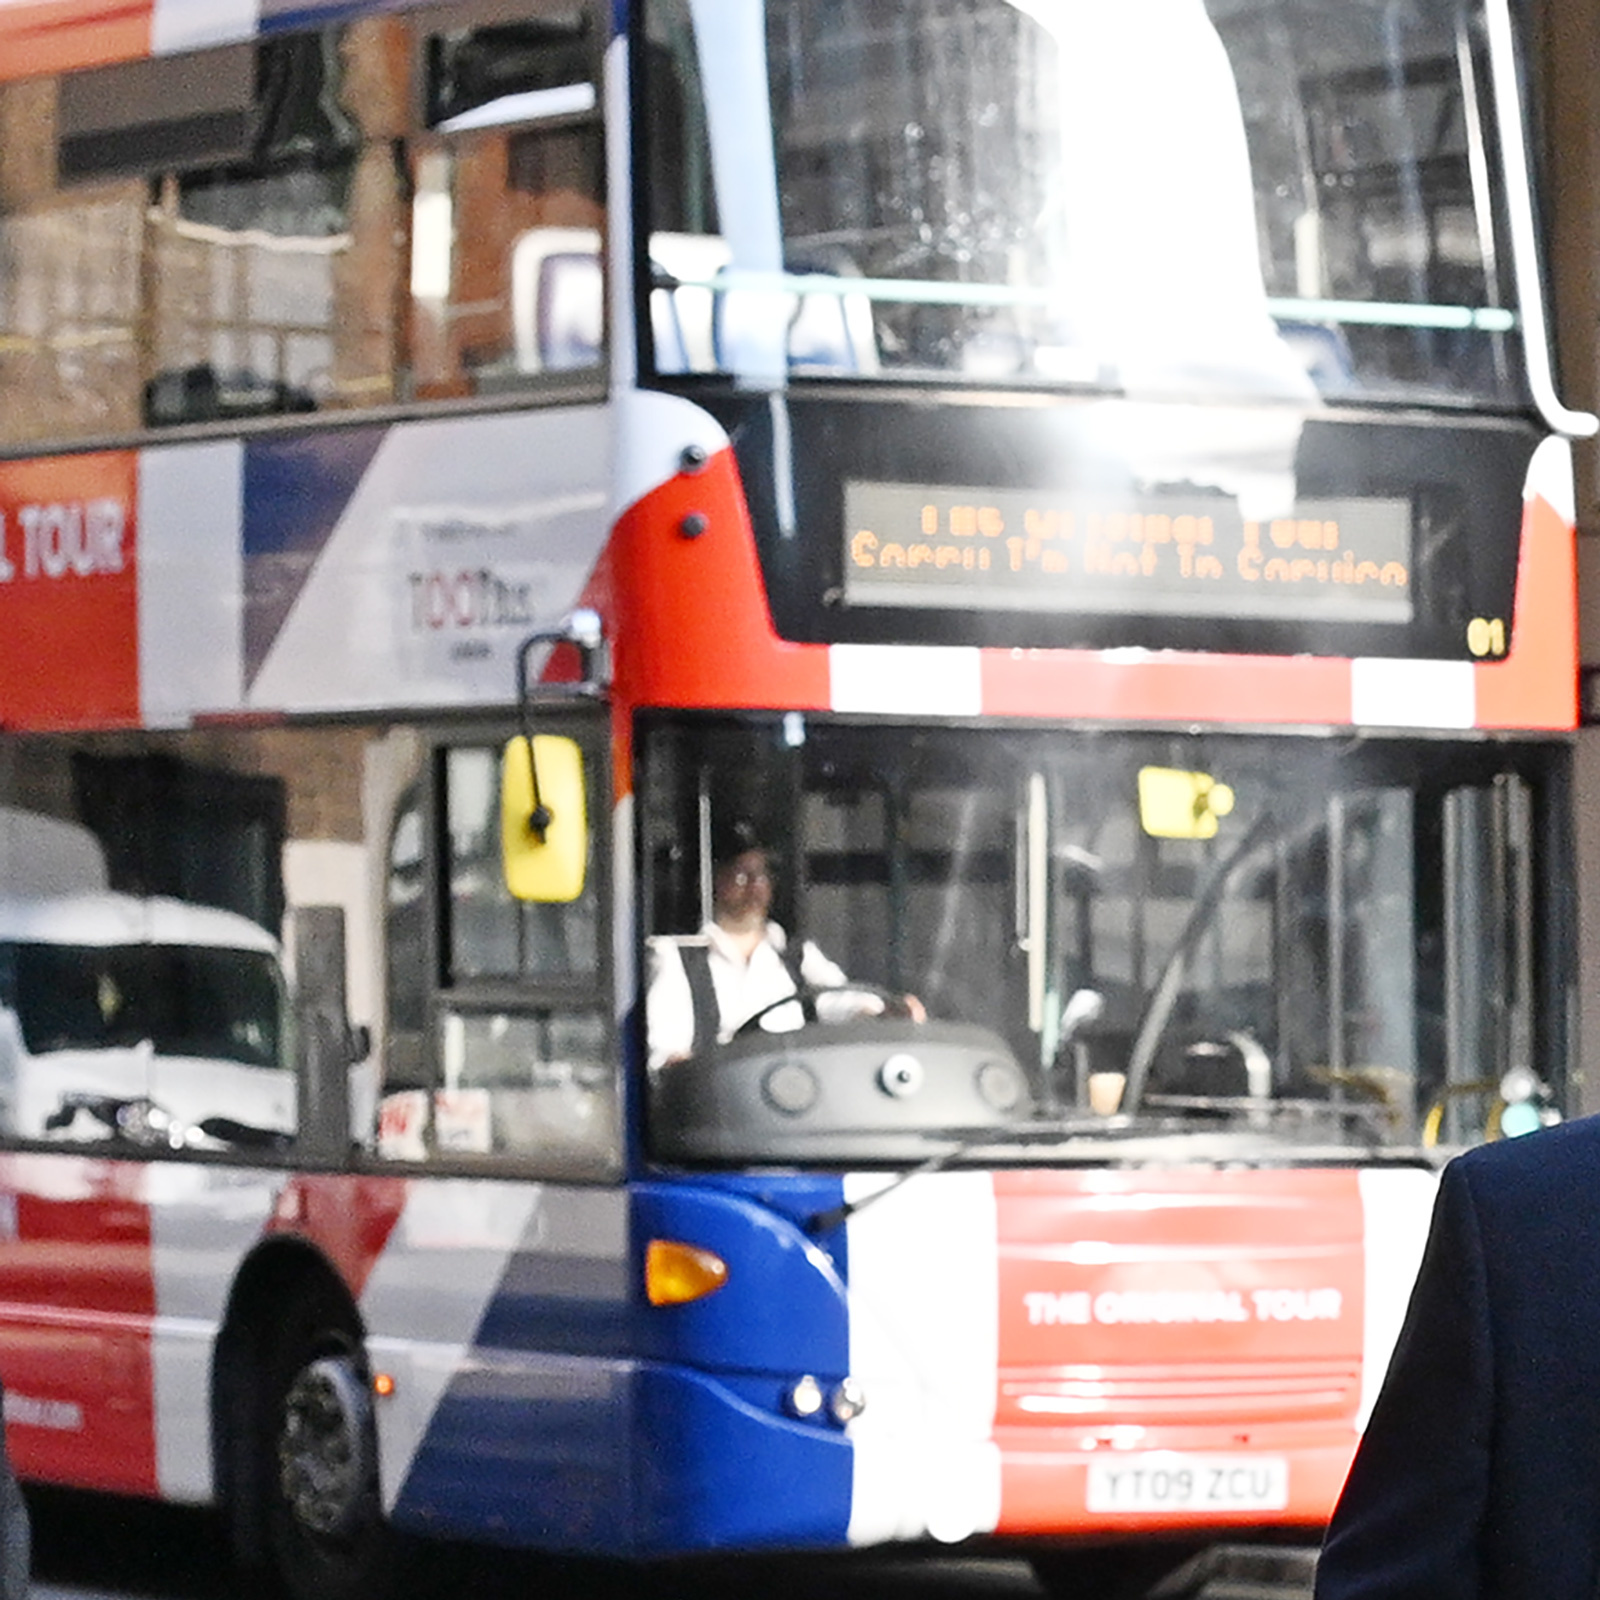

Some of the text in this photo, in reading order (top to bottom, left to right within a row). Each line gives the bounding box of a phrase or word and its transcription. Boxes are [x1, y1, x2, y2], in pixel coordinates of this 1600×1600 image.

[18, 501, 124, 578] TOUR
[1023, 1291, 1091, 1324] THE
[1251, 1288, 1342, 1322] TOUR
[1105, 1467, 1272, 1501] YT09 ZCU
